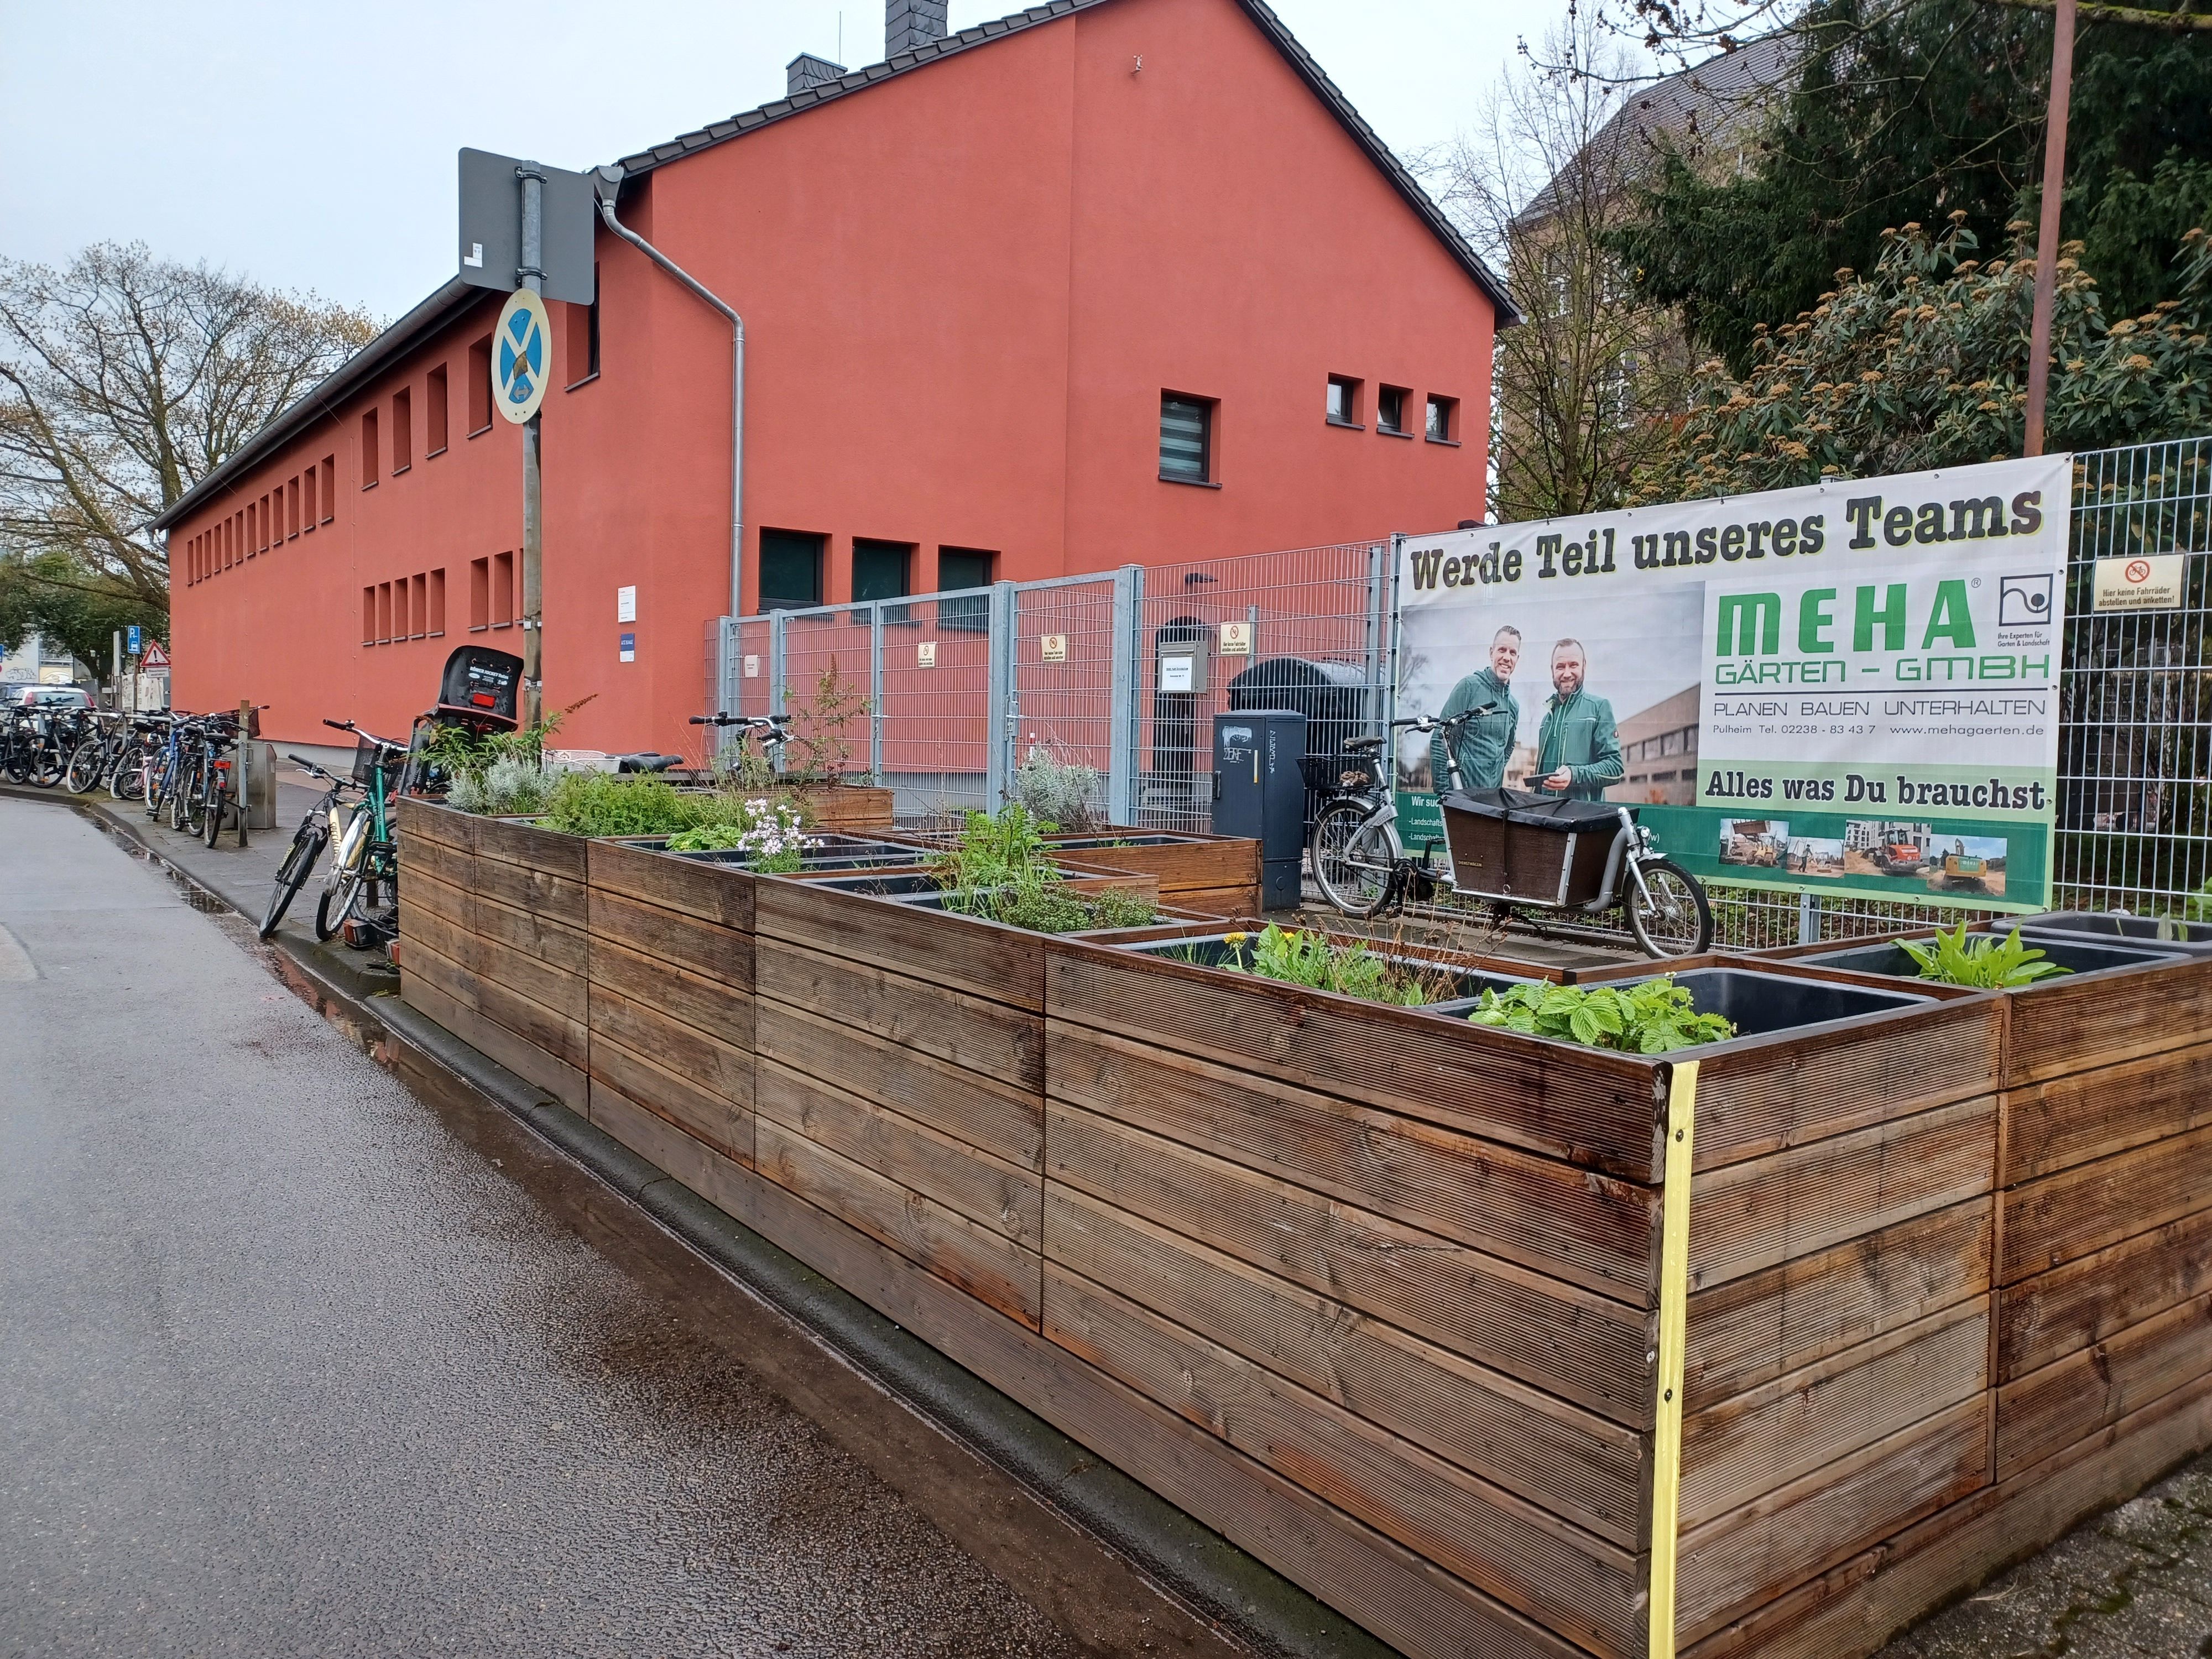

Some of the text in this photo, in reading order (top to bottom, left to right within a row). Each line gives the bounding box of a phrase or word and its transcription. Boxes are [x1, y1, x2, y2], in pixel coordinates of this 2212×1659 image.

[1411, 491, 2042, 590] Werde Teil unseres Teams
[2103, 588, 2115, 597] Hier
[2137, 586, 2171, 594] Fahrräder
[2099, 598, 2127, 607] abstellen
[2143, 596, 2175, 604] anketten!
[1715, 660, 1846, 685] GÄRTEN
[1714, 700, 2046, 716] PLANEN BAUEN UNTERHALTEN
[1713, 725, 1751, 733] Pulheim
[1759, 725, 1777, 733] Tel.
[1781, 725, 1817, 734] 02238
[1830, 725, 1844, 734] 83
[1848, 725, 1863, 734] 43
[1869, 725, 1876, 734] 7
[1890, 724, 2044, 737] www.mehagaerten.de
[1705, 771, 2045, 810] Alles was Du brauchst
[1411, 796, 1439, 807] Wir suc
[1408, 817, 1443, 827] -Landschafts
